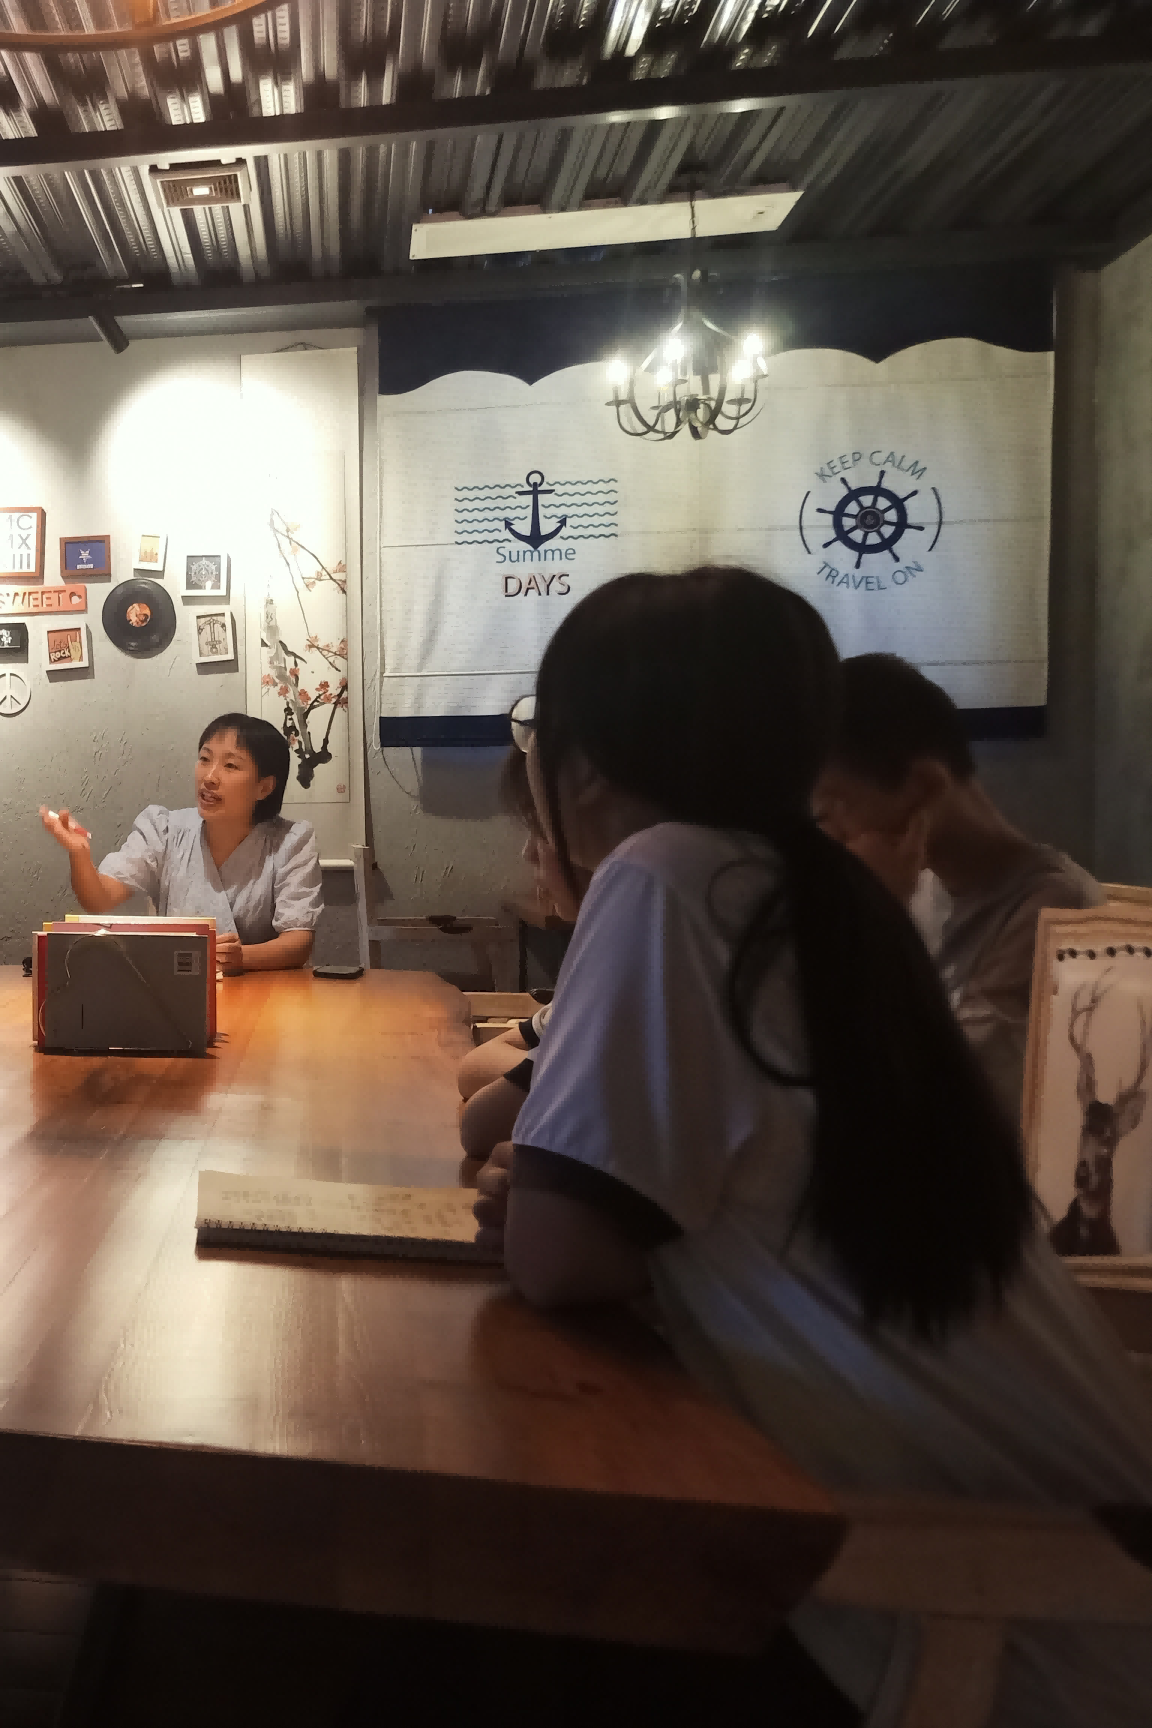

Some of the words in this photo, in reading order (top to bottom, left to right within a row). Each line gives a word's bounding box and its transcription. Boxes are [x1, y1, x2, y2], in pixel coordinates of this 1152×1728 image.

[814, 452, 862, 483] KEEP
[869, 450, 927, 480] CALM
[496, 546, 576, 563] Summe
[501, 572, 571, 598] DAYS
[816, 561, 887, 591] TRAVEL
[892, 561, 924, 586] ON
[50, 648, 71, 662] ROCK
